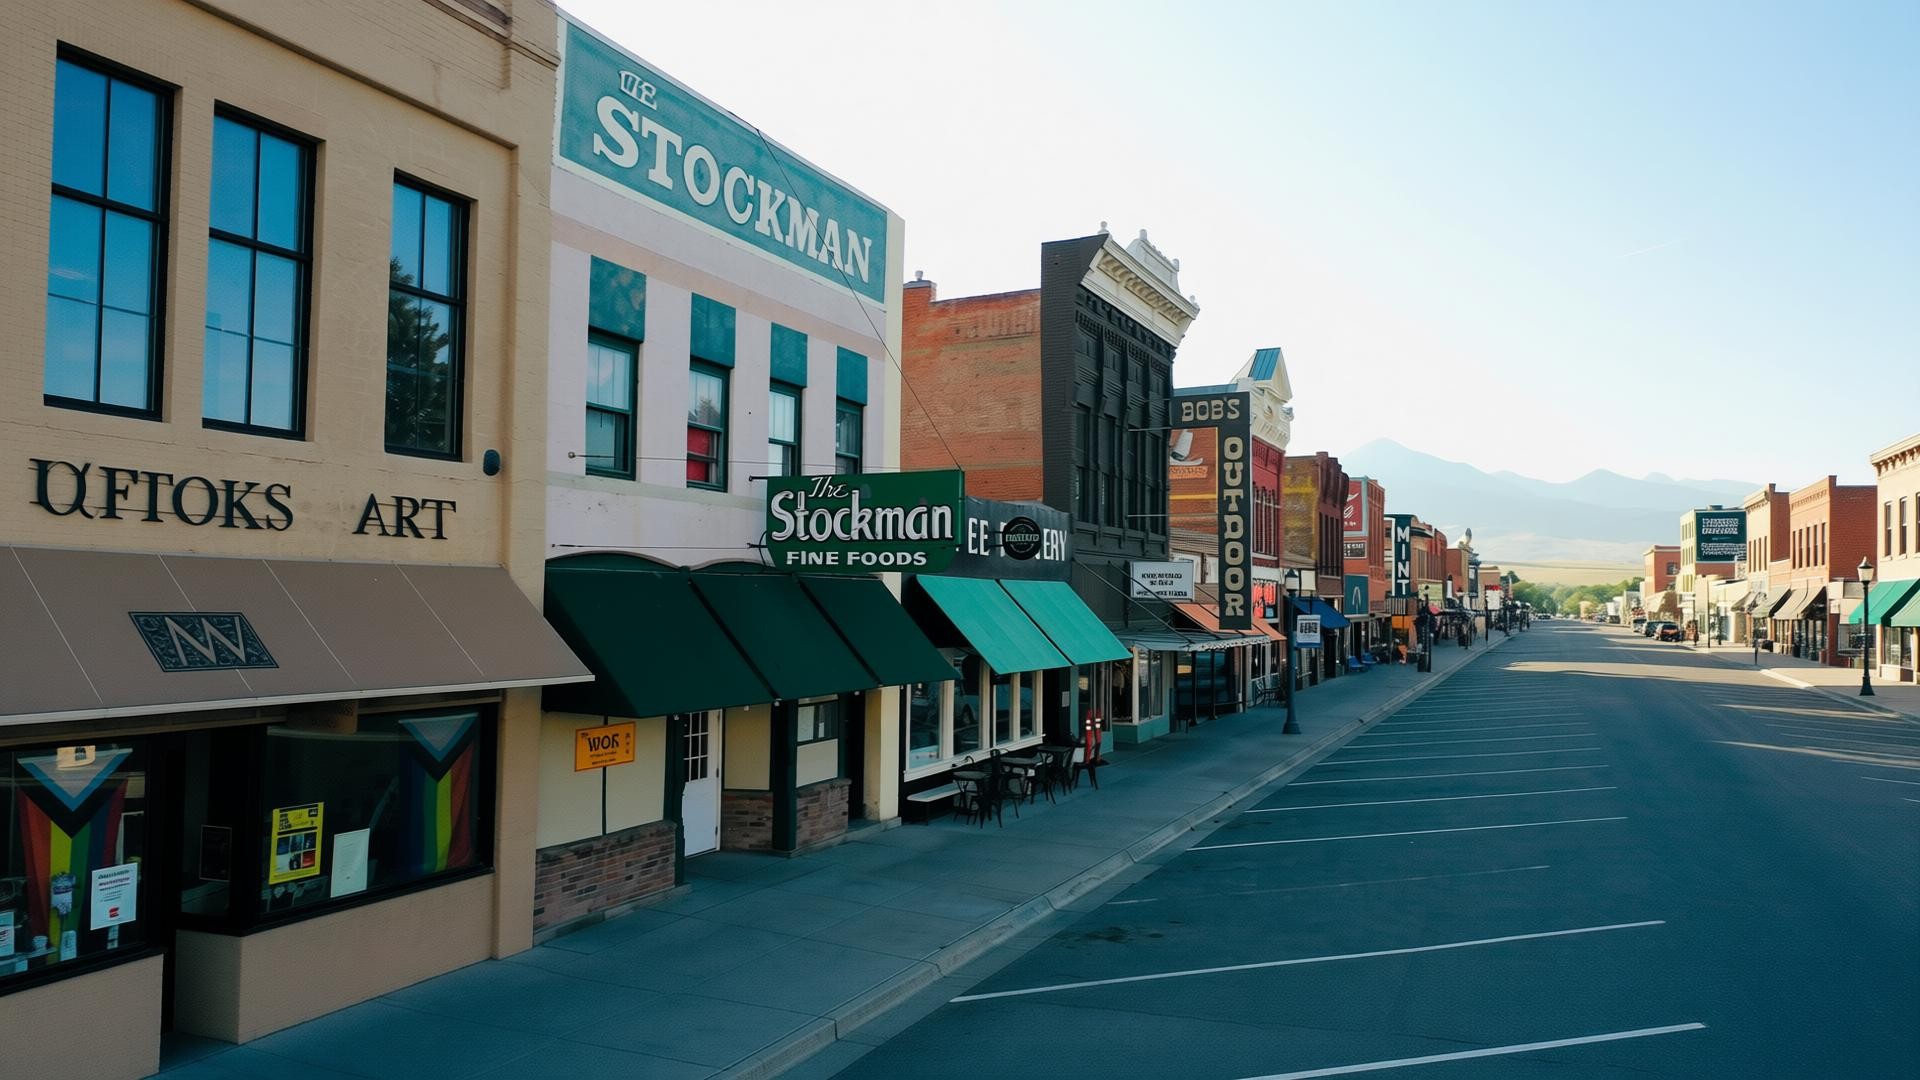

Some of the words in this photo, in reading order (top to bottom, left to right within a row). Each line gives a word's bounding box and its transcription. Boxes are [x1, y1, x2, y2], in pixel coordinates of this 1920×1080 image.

[593, 96, 872, 283] STOCKMAN
[1181, 397, 1241, 422] BOB'S
[808, 476, 849, 498] The
[352, 493, 456, 540] ART
[770, 489, 954, 543] Stockman
[1223, 437, 1244, 617] OUTDOOR
[786, 551, 839, 565] FINE
[847, 551, 927, 566] FOODS
[1396, 526, 1410, 595] MINT
